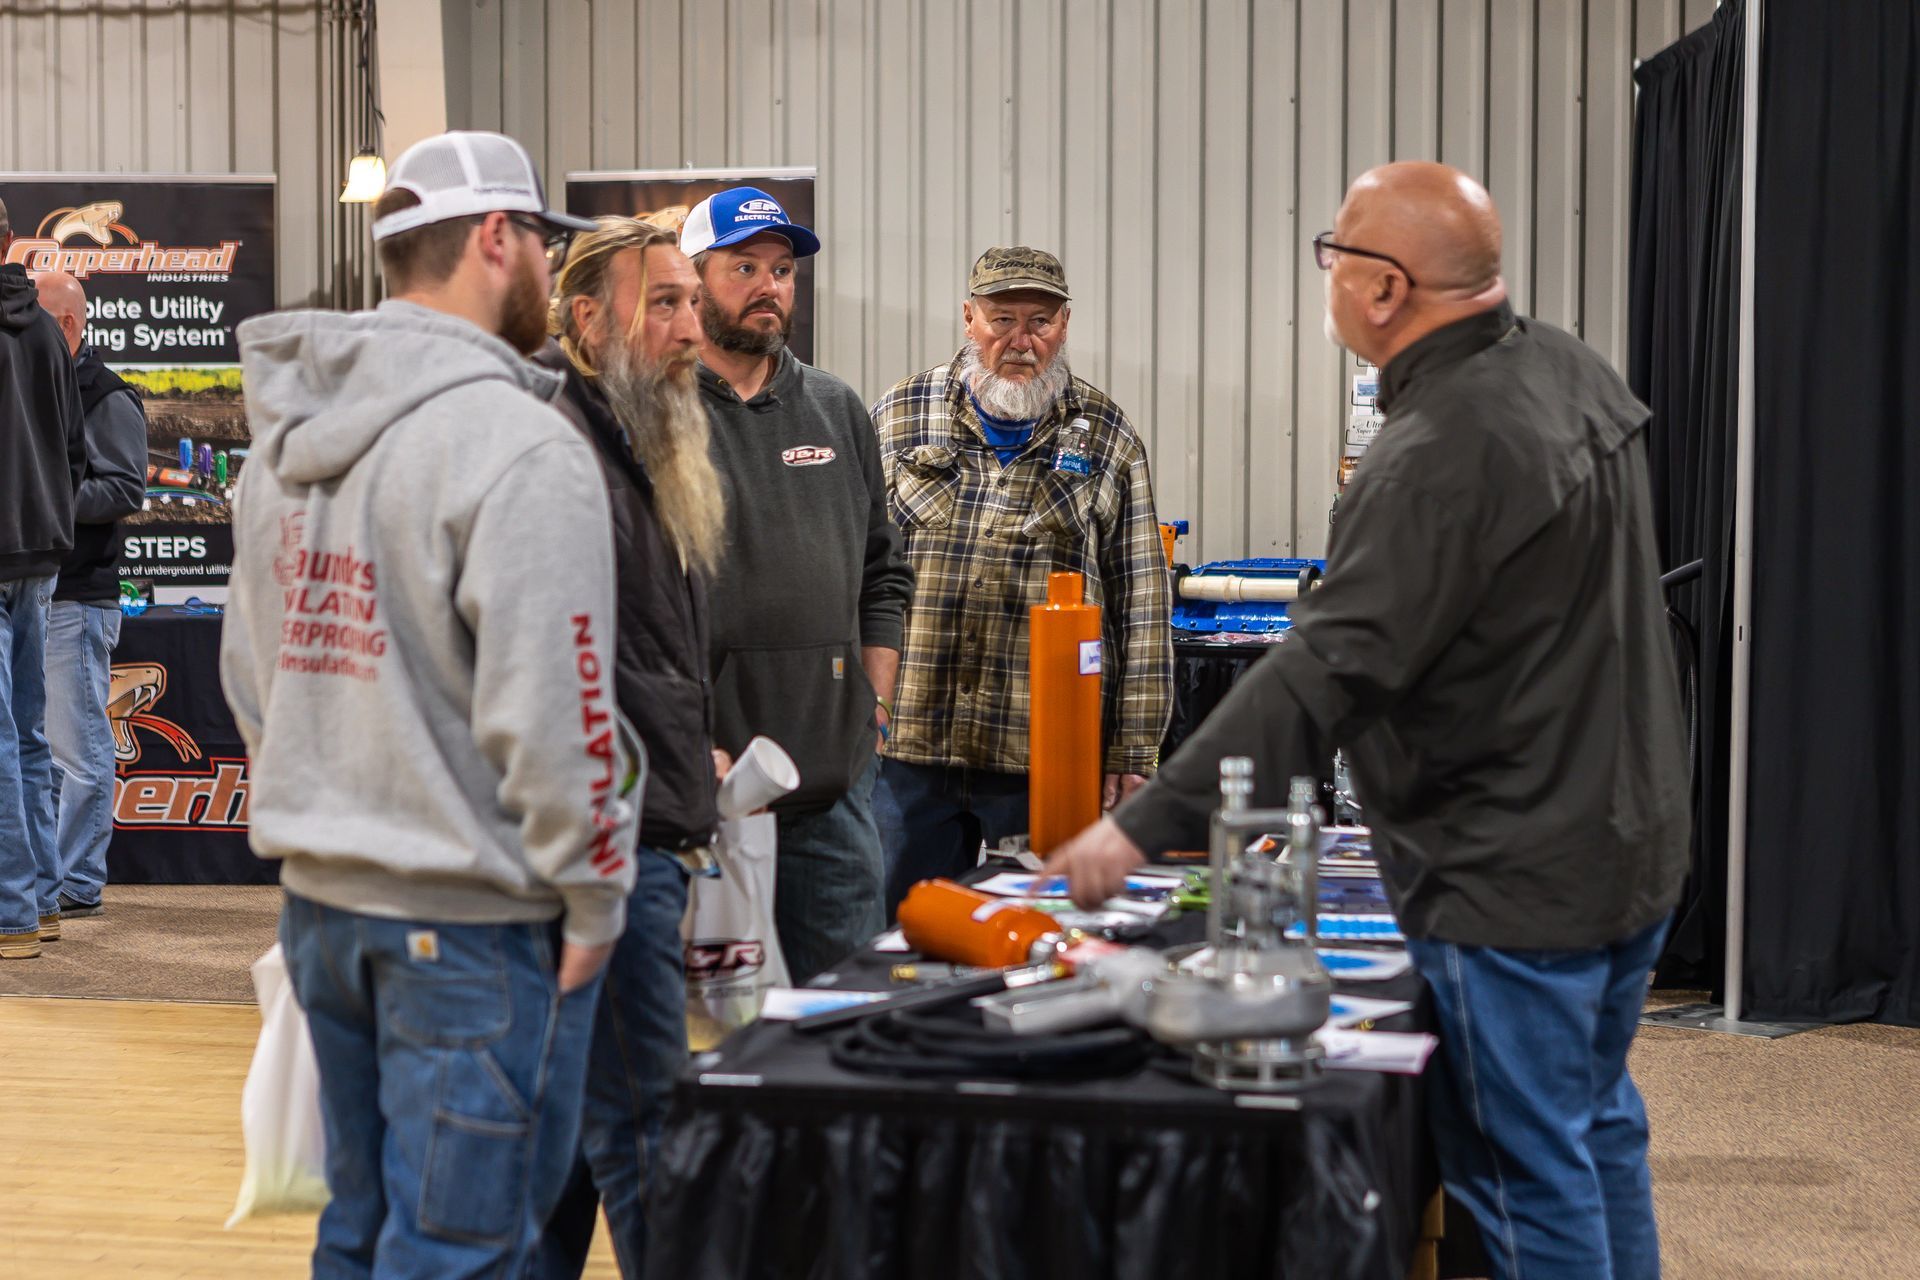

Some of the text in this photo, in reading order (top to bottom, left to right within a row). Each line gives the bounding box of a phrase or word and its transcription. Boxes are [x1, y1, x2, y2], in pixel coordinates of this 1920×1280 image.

[735, 214, 771, 222] ELECTRIC
[5, 239, 237, 279] Copperhead
[147, 272, 229, 283] INDUSTRIES
[149, 295, 224, 324] Utility
[124, 536, 207, 559] STEPS
[133, 564, 143, 575] of
[145, 564, 204, 577] underground
[206, 564, 233, 575] utilitie
